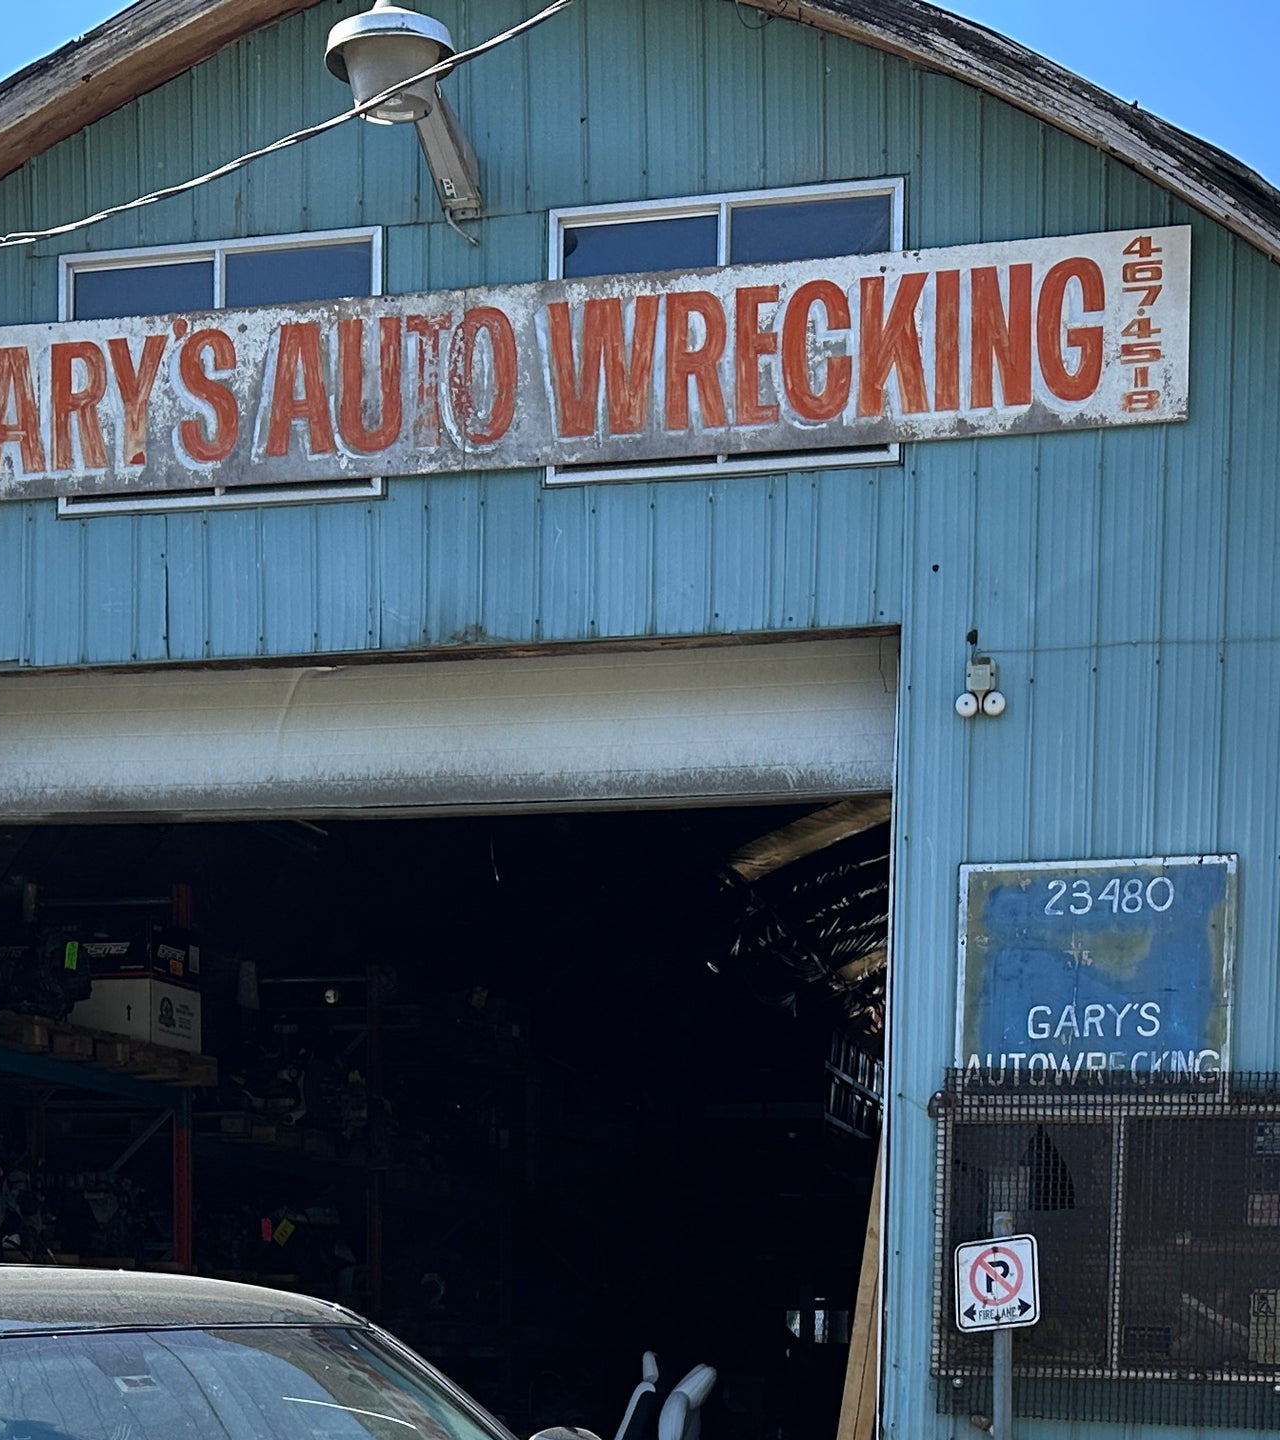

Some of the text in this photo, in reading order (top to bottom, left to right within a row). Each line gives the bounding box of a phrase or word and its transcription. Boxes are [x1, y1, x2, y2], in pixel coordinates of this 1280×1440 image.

[265, 305, 518, 457] AUTO
[547, 256, 1106, 437] WRECKING
[1044, 876, 1175, 916] 23480
[1027, 1002, 1161, 1039] GARY'S
[978, 1309, 995, 1321] FIRE
